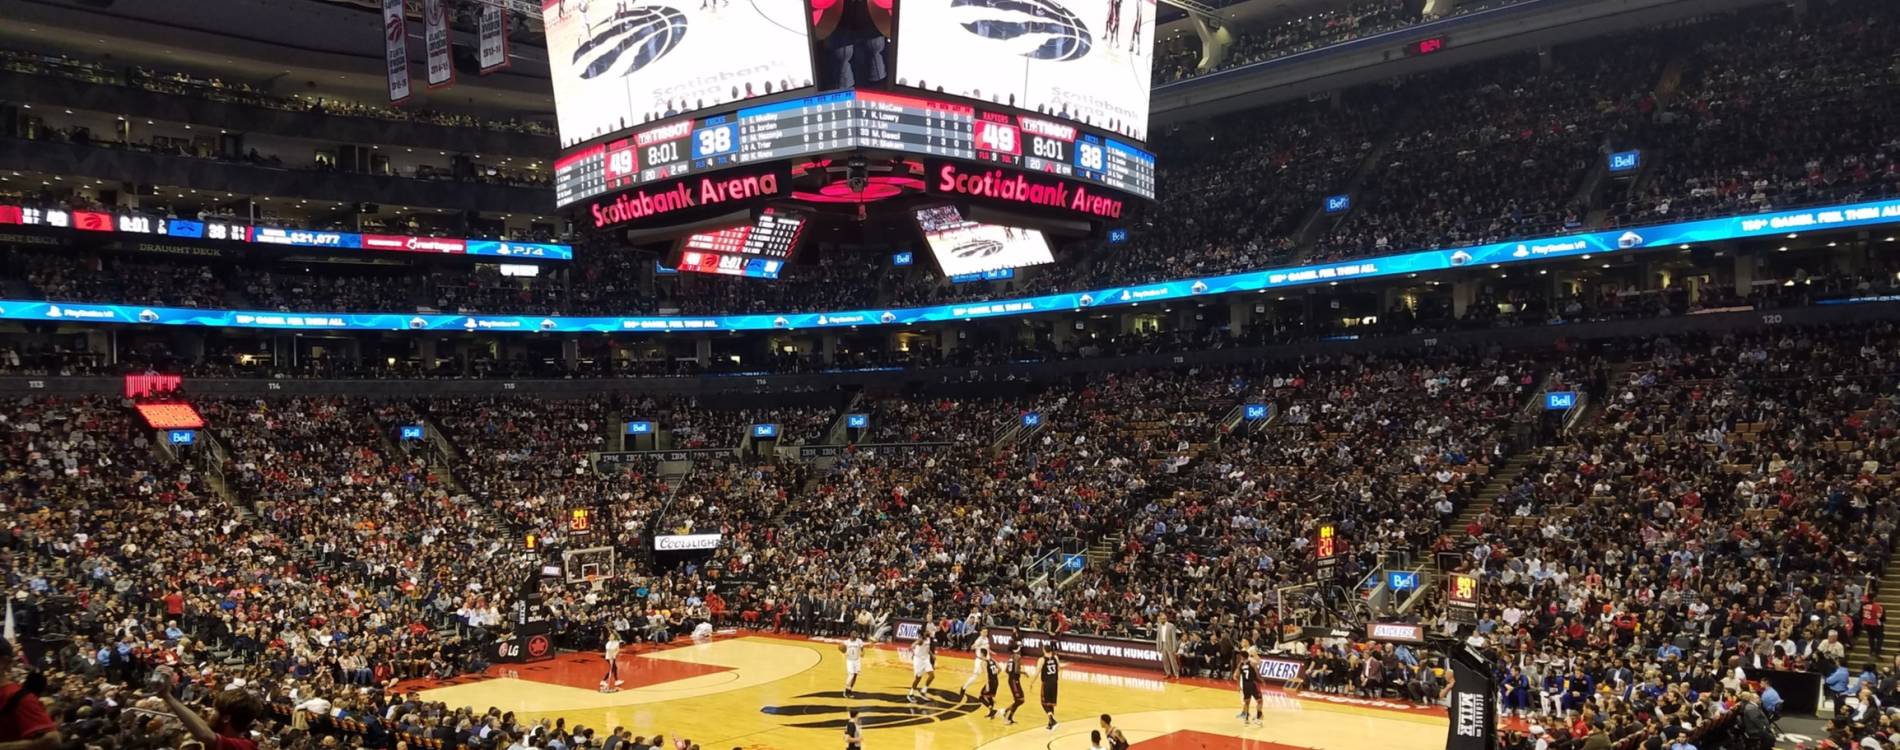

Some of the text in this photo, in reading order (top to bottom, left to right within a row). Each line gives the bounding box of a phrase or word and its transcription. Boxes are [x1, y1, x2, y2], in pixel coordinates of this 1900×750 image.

[879, 114, 900, 123] Lowry
[698, 126, 731, 156] 38
[982, 123, 1015, 152] 49
[647, 141, 679, 166] 8:01
[1033, 136, 1064, 161] 8:01
[610, 149, 632, 176] 49
[1080, 143, 1102, 170] 38
[1614, 154, 1635, 168] Bell
[670, 165, 676, 175] 2
[1029, 158, 1041, 169] 20
[1056, 164, 1062, 174] 2
[645, 170, 656, 181] 20
[939, 165, 1069, 208] Scotiabank
[1070, 186, 1123, 219] Arena
[591, 181, 696, 228] Scotiabank
[700, 173, 778, 205] Arena
[1818, 211, 1844, 223] FEEL
[1845, 207, 1880, 220] THEM
[119, 214, 151, 234] 8:01
[208, 222, 227, 240] 38
[291, 231, 341, 245] $21,077
[139, 243, 222, 257] DRAUGHT DECK
[512, 245, 545, 256] PS4
[1531, 243, 1574, 255] PlayStation
[896, 254, 910, 264] Bell
[1762, 314, 1782, 325] 120
[1550, 394, 1571, 407] Bell
[851, 417, 864, 426] Bell
[1025, 415, 1037, 425] Bell
[632, 423, 647, 432] Bell
[758, 426, 772, 436] Bell
[173, 432, 190, 443] Bell
[570, 517, 587, 530] 20
[659, 537, 692, 549] Coors
[1318, 538, 1333, 557] 20
[1455, 586, 1472, 600] 20
[1375, 626, 1414, 637] SNICKERS
[508, 644, 520, 657] LG
[1023, 639, 1163, 662] NOT WHEN YOU'RE HUNGRY
[1046, 664, 1058, 676] 33
[1243, 668, 1250, 679] 7
